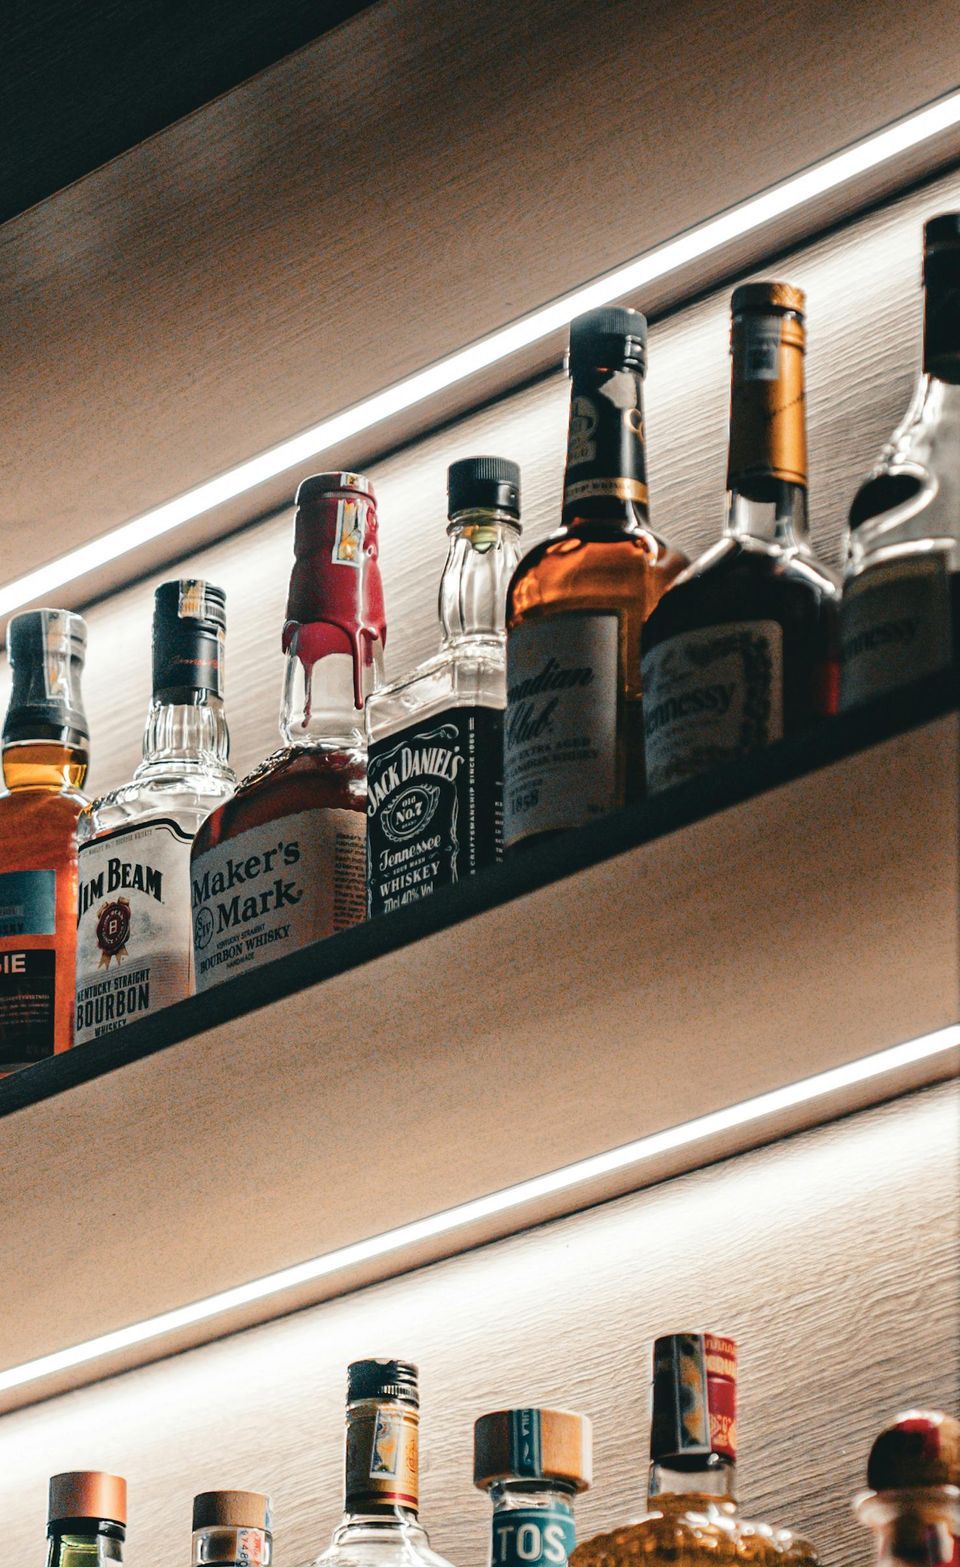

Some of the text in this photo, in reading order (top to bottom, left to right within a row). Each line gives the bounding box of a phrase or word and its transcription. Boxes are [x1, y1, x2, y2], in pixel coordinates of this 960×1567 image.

[367, 746, 466, 818] JACK DANIEL'S
[401, 796, 417, 808] Old
[192, 841, 301, 909] Maker's
[379, 834, 441, 872] Tennessee
[77, 871, 105, 930] JIM
[107, 857, 164, 904] BEAM
[380, 861, 441, 897] WHISKEY
[216, 878, 304, 934] Mark
[200, 924, 291, 974] BOURBON WHISKY
[114, 968, 151, 990] STRAIGHT
[76, 982, 150, 1032] BOURBON
[492, 1522, 568, 1563] TOS
